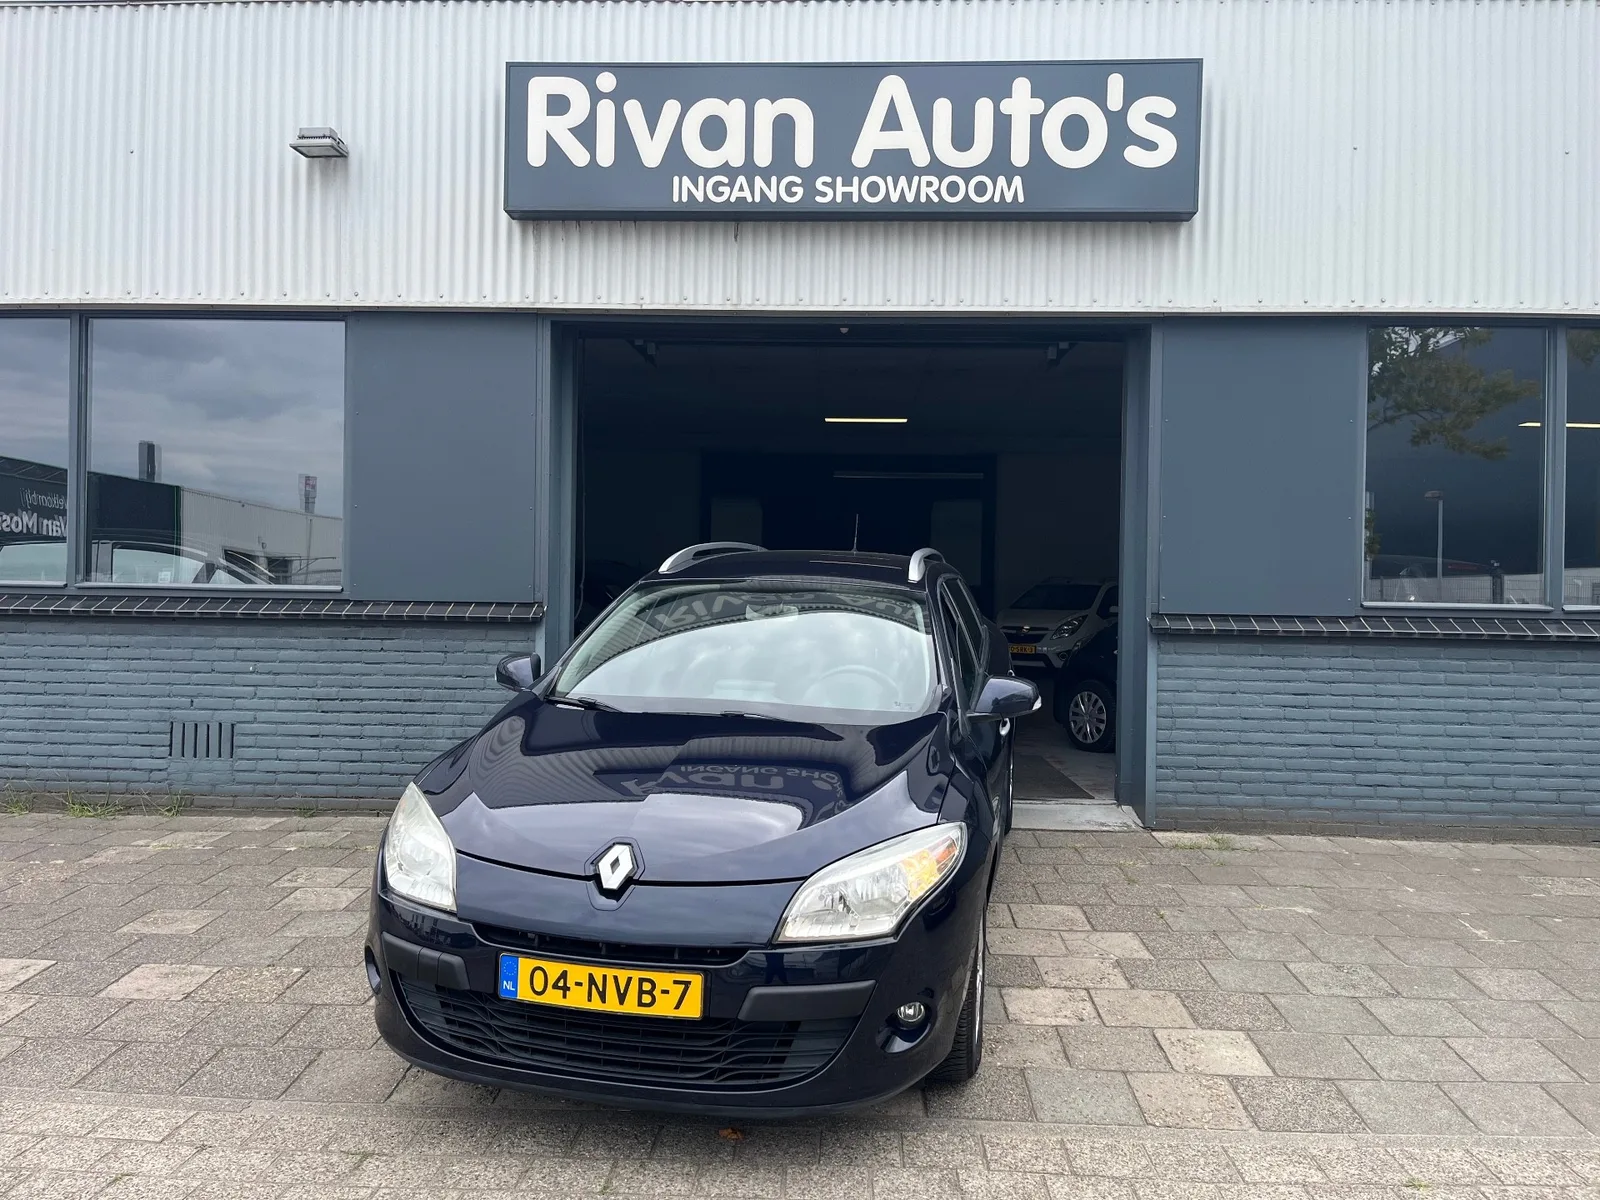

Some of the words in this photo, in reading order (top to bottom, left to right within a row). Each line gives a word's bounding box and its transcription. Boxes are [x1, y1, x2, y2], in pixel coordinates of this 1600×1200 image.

[528, 72, 813, 168] Rivan
[851, 73, 1177, 168] Auto's
[673, 175, 803, 203] INGANG
[815, 175, 1024, 203] SHOWROOM
[503, 981, 515, 991] NL
[529, 966, 692, 1010] 04-NVB-7
